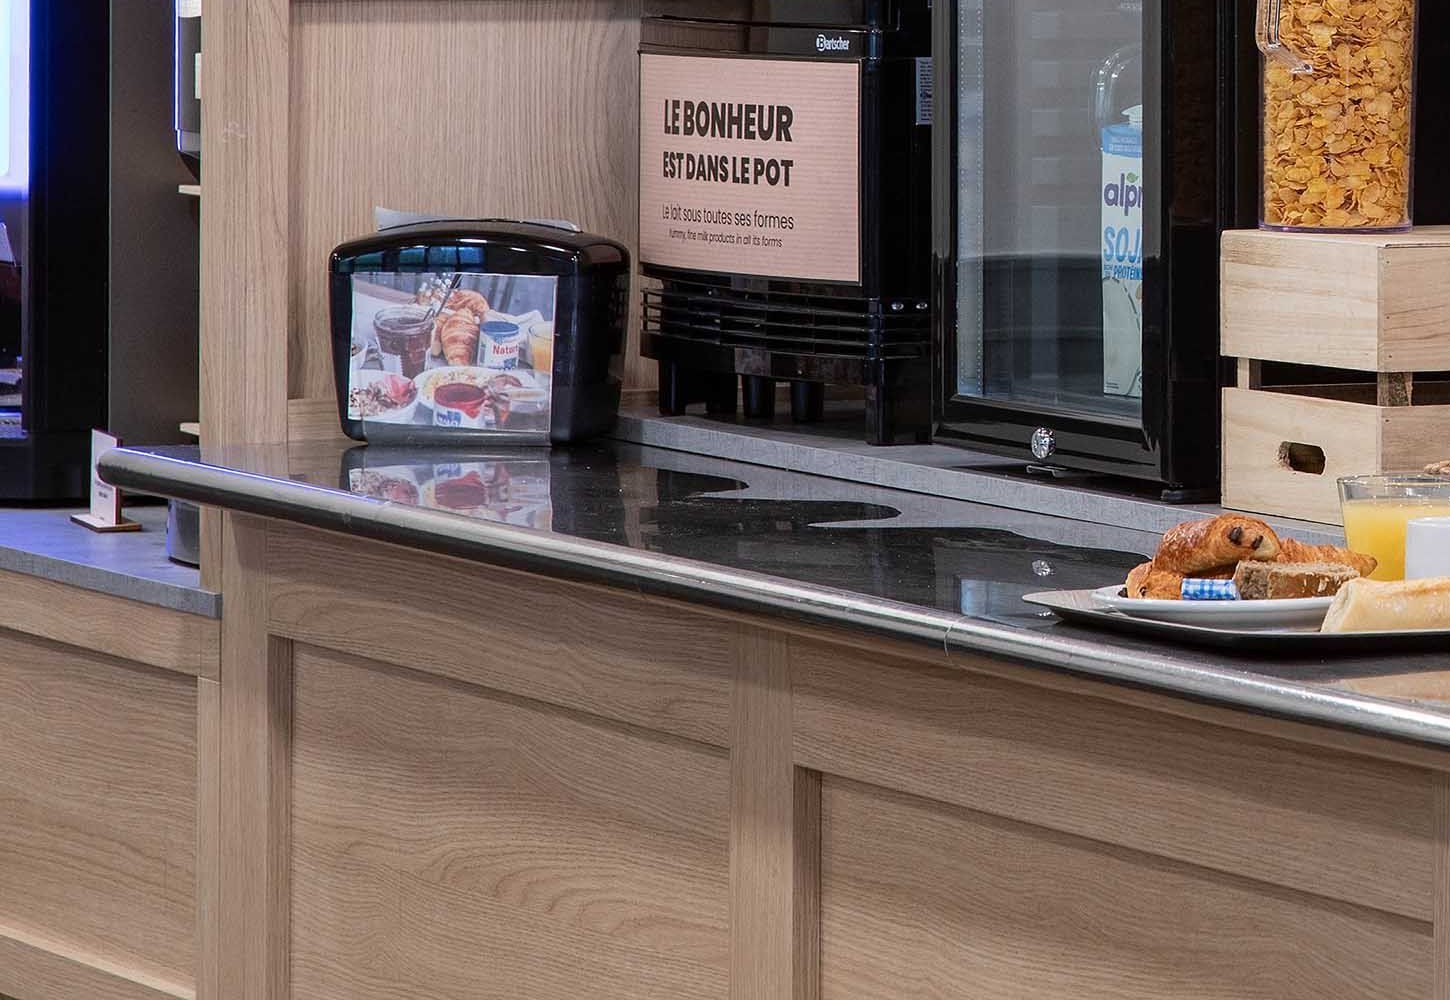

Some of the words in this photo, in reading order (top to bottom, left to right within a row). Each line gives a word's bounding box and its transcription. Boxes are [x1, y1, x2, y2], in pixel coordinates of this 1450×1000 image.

[816, 34, 850, 51] Bartscher
[663, 98, 680, 135] LE
[683, 100, 793, 142] BONHEUR
[663, 151, 684, 180] EST
[686, 152, 729, 183] DANS
[732, 156, 750, 185] LE
[753, 157, 794, 187] POT
[662, 203, 670, 220] Le
[671, 203, 682, 221] lait
[683, 207, 702, 223] sous
[703, 207, 733, 226] toutes
[734, 211, 752, 227] ses
[753, 209, 795, 230] formes
[709, 231, 736, 245] products
[736, 233, 743, 244] in
[752, 235, 761, 246] its
[761, 235, 784, 248] forms
[1103, 225, 1142, 263] SOJ
